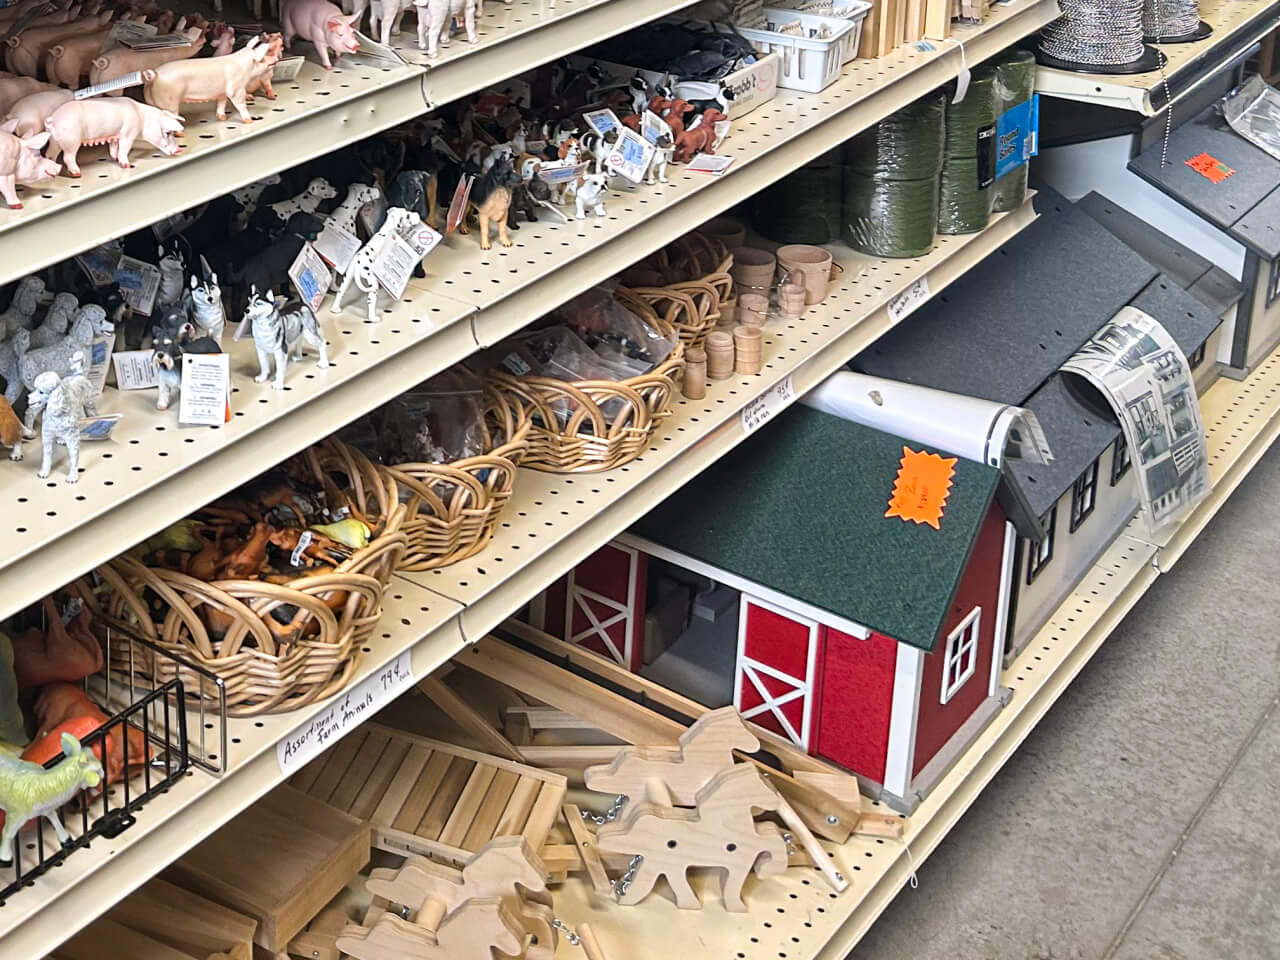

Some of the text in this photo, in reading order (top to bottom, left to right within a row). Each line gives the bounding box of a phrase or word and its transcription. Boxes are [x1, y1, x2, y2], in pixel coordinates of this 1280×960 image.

[284, 707, 335, 764] Assortment
[340, 694, 351, 712] of
[317, 691, 374, 744] Farm Animals
